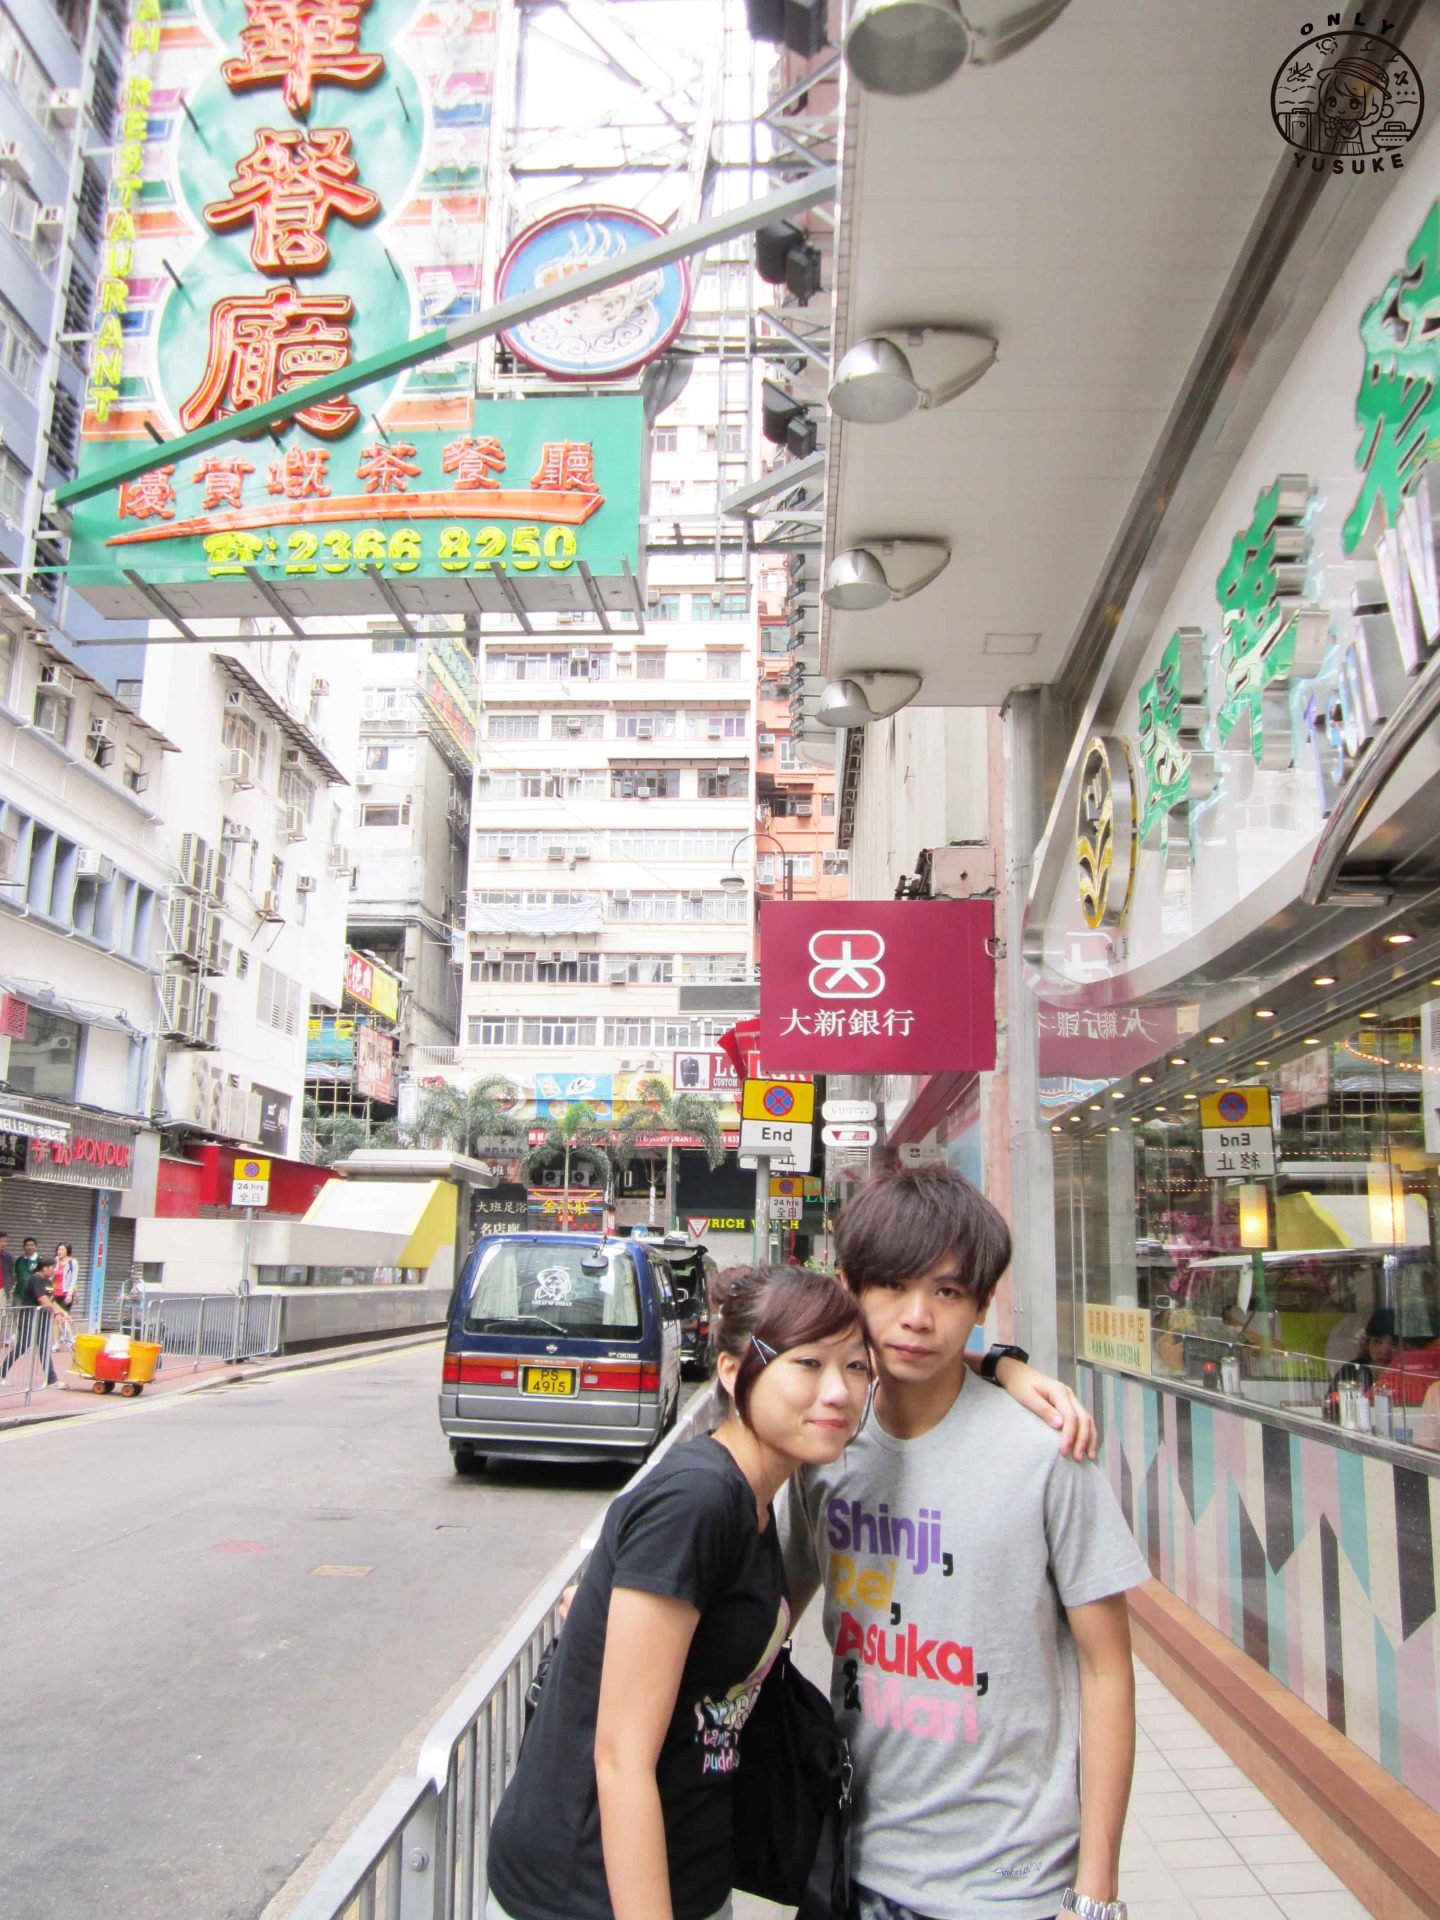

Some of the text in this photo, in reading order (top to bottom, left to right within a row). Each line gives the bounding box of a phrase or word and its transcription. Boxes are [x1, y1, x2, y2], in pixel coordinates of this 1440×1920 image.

[90, 76, 151, 423] RESTAURANT
[438, 526, 577, 572] 8250
[780, 1008, 916, 1038] 大新銀行
[761, 1127, 793, 1142] End
[74, 1136, 129, 1168] BONJOUR
[237, 1182, 264, 1191] 24 hrs
[239, 1193, 261, 1203] 全日
[774, 1199, 799, 1207] 24 hrs
[777, 1207, 797, 1218] 全日
[533, 1381, 566, 1393] 4915
[541, 1370, 559, 1381] PS
[826, 1499, 954, 1576] Shinji,
[830, 1555, 902, 1626] Rei,
[835, 1612, 989, 1697] Asuka,
[861, 1669, 980, 1745] Mari
